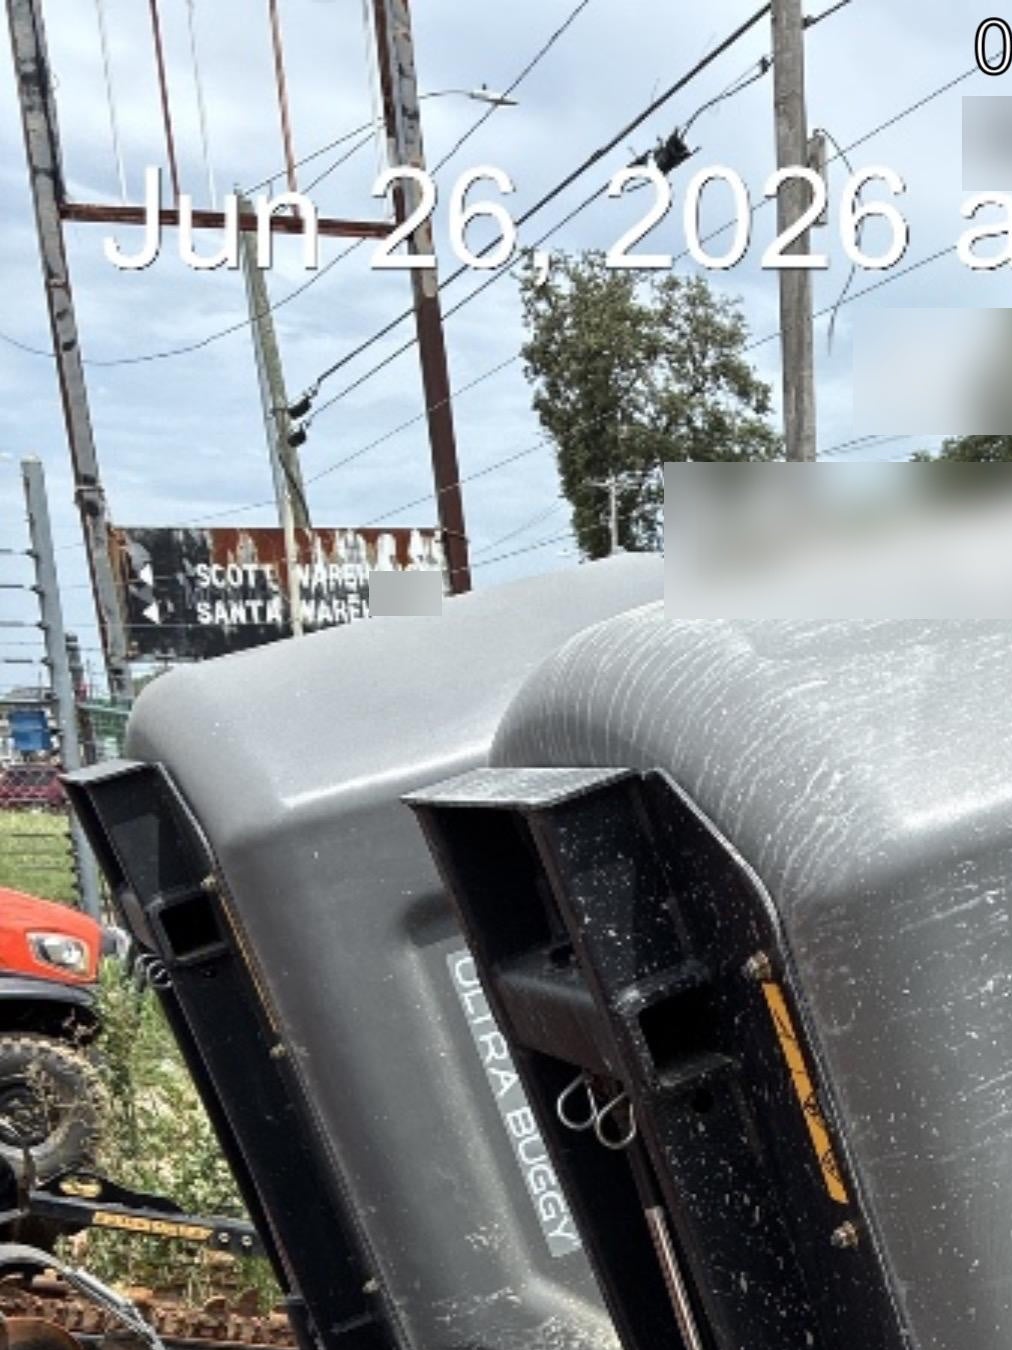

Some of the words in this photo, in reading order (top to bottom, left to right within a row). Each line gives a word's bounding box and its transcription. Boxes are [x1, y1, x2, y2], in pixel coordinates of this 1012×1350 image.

[197, 563, 282, 590] SCOTT
[197, 599, 283, 625] SANTA
[506, 1106, 577, 1240] BUGGY
